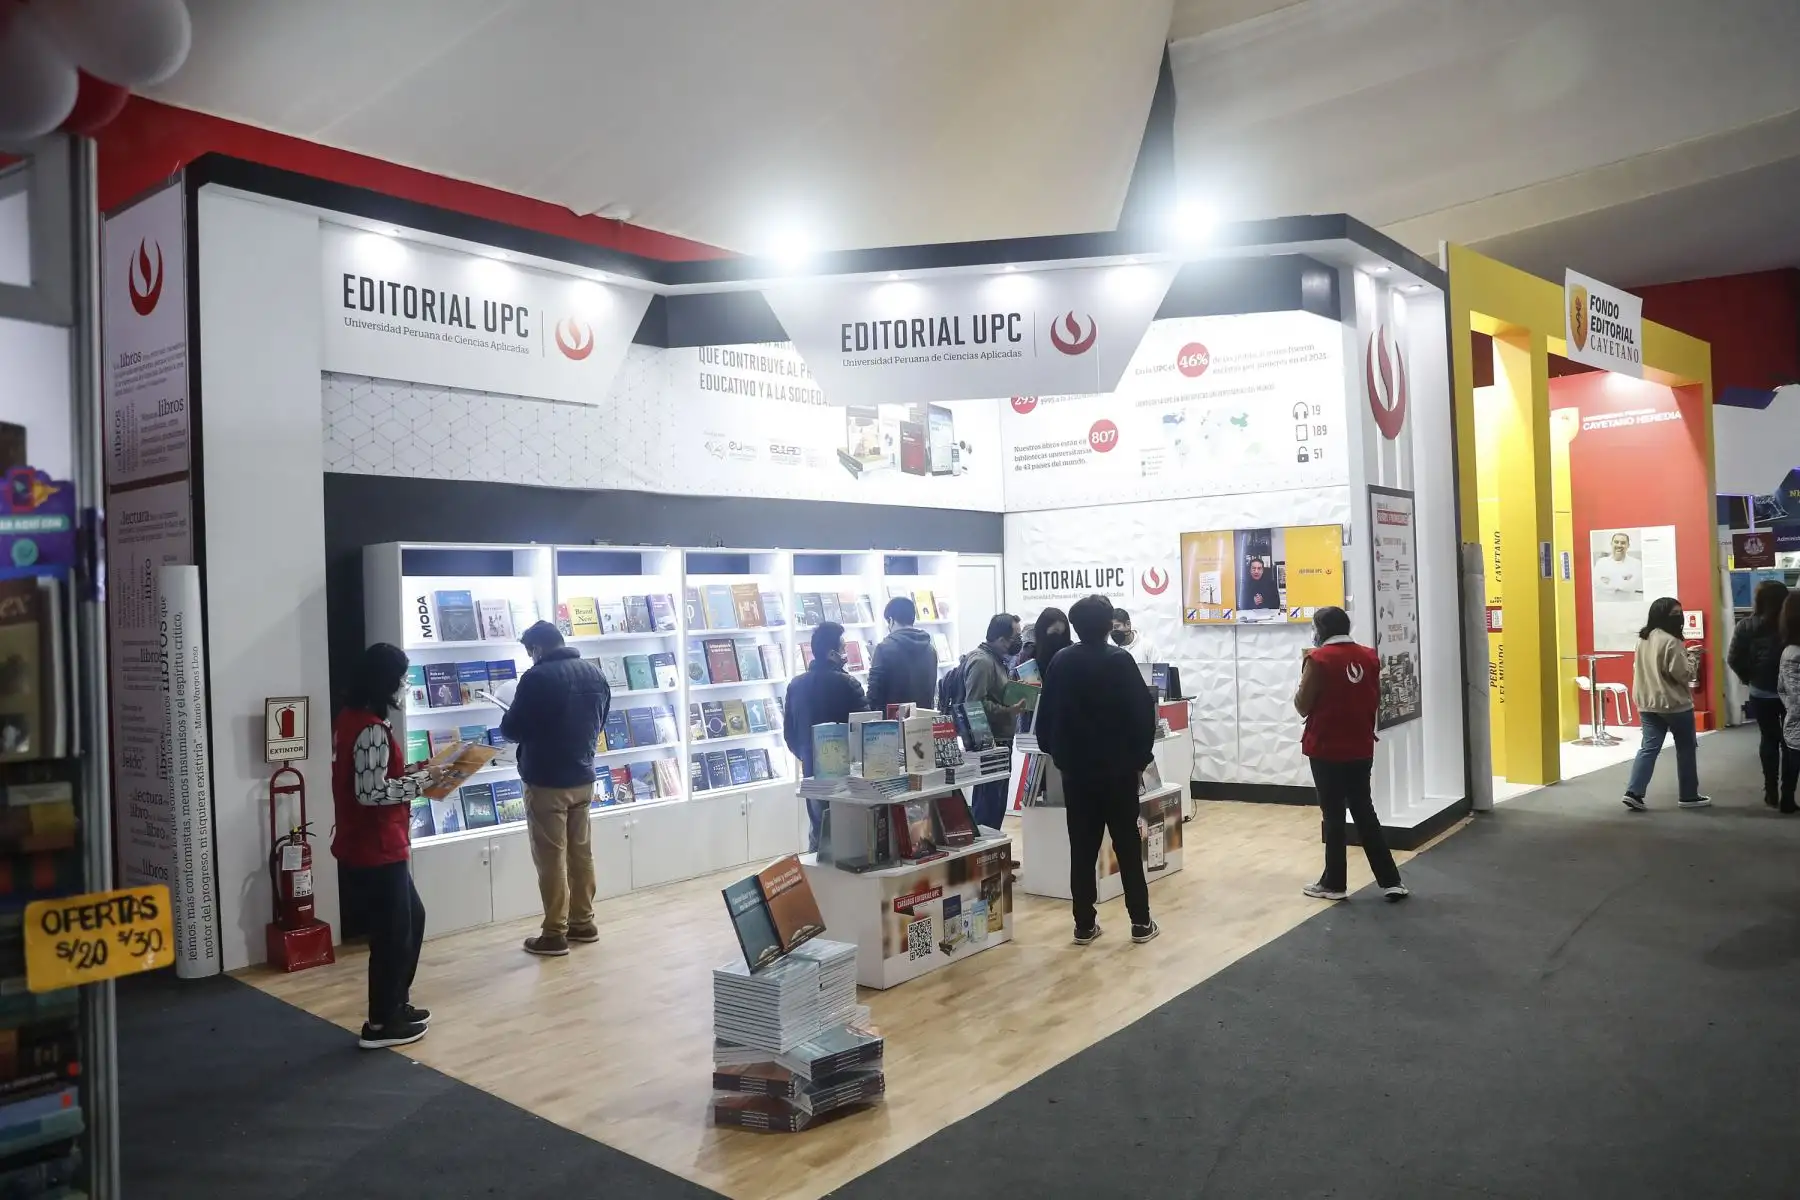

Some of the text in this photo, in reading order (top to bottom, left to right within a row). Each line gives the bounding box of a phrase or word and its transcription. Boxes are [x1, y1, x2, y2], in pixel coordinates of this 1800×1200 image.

[343, 273, 529, 338] EDITORIAL UPC
[1589, 294, 1619, 320] FONDO
[344, 316, 530, 355] Universidad Peruana de Ciencias Aplicadas
[841, 312, 1022, 353] EDITORIAL UPC
[1590, 318, 1634, 345] EDITORIAL
[120, 351, 142, 369] libros
[842, 349, 1022, 367] Universidad Peruana de Ciencias Aplicadas
[1179, 352, 1209, 368] 46%
[1590, 334, 1640, 364] CAYETANO
[698, 346, 720, 366] QUE
[722, 349, 785, 376] CONTRIBUYE
[786, 360, 799, 377] AL
[699, 371, 831, 407] EDUCATIVO Y A LA SOCIEDA
[158, 397, 184, 417] libros
[1311, 404, 1321, 416] 19
[1312, 424, 1328, 437] 189
[1583, 410, 1681, 431] CAYETANO HEREDIA
[1091, 429, 1117, 444] 807
[1014, 452, 1048, 463] bibliotecas
[1313, 447, 1323, 460] 51
[1021, 567, 1124, 591] EDITORIAL UPC
[416, 594, 433, 638] MODA
[575, 606, 593, 616] Brand
[577, 614, 593, 622] New
[191, 646, 200, 670] Llosa
[192, 670, 203, 702] Vargas
[193, 703, 202, 729] Mario
[269, 745, 304, 755] EXTINTOR
[166, 757, 174, 774] sin
[168, 776, 176, 812] somos
[172, 611, 198, 961] leímos, más conformistas, menos insumisos y el espíritu crítico,
[196, 790, 208, 836] siquiera
[197, 837, 208, 848] ni
[142, 857, 168, 881] libros
[200, 850, 212, 904] progreso,
[40, 895, 158, 935] OFERTAS
[201, 904, 212, 922] del
[203, 924, 214, 959] motor
[55, 938, 108, 970] S/20
